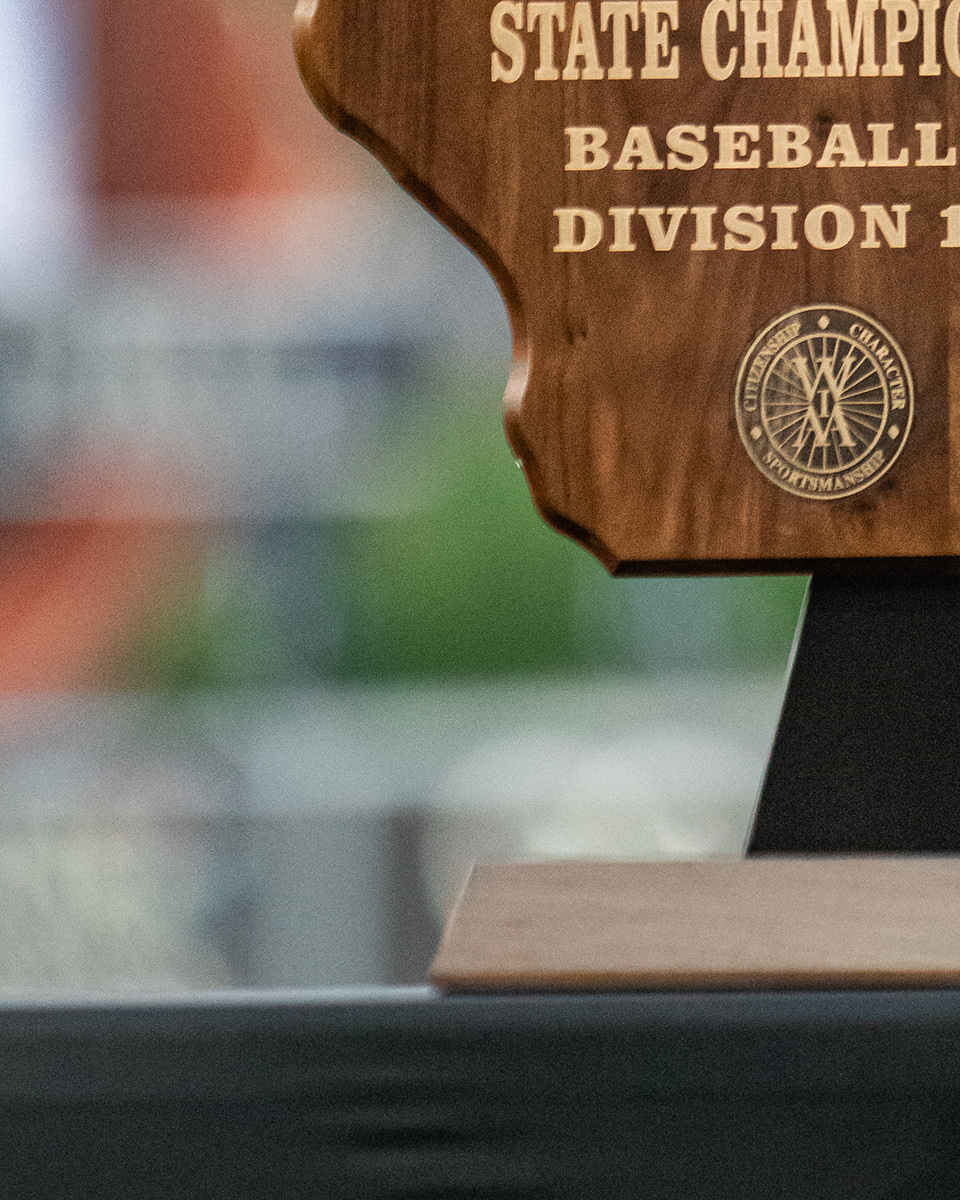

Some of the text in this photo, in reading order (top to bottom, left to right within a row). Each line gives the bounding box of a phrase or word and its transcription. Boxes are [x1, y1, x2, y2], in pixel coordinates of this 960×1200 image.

[490, 0, 680, 83] STATE
[564, 122, 957, 171] BASEBALL
[553, 204, 912, 253] DIVISION
[849, 323, 906, 410] CHARACTER
